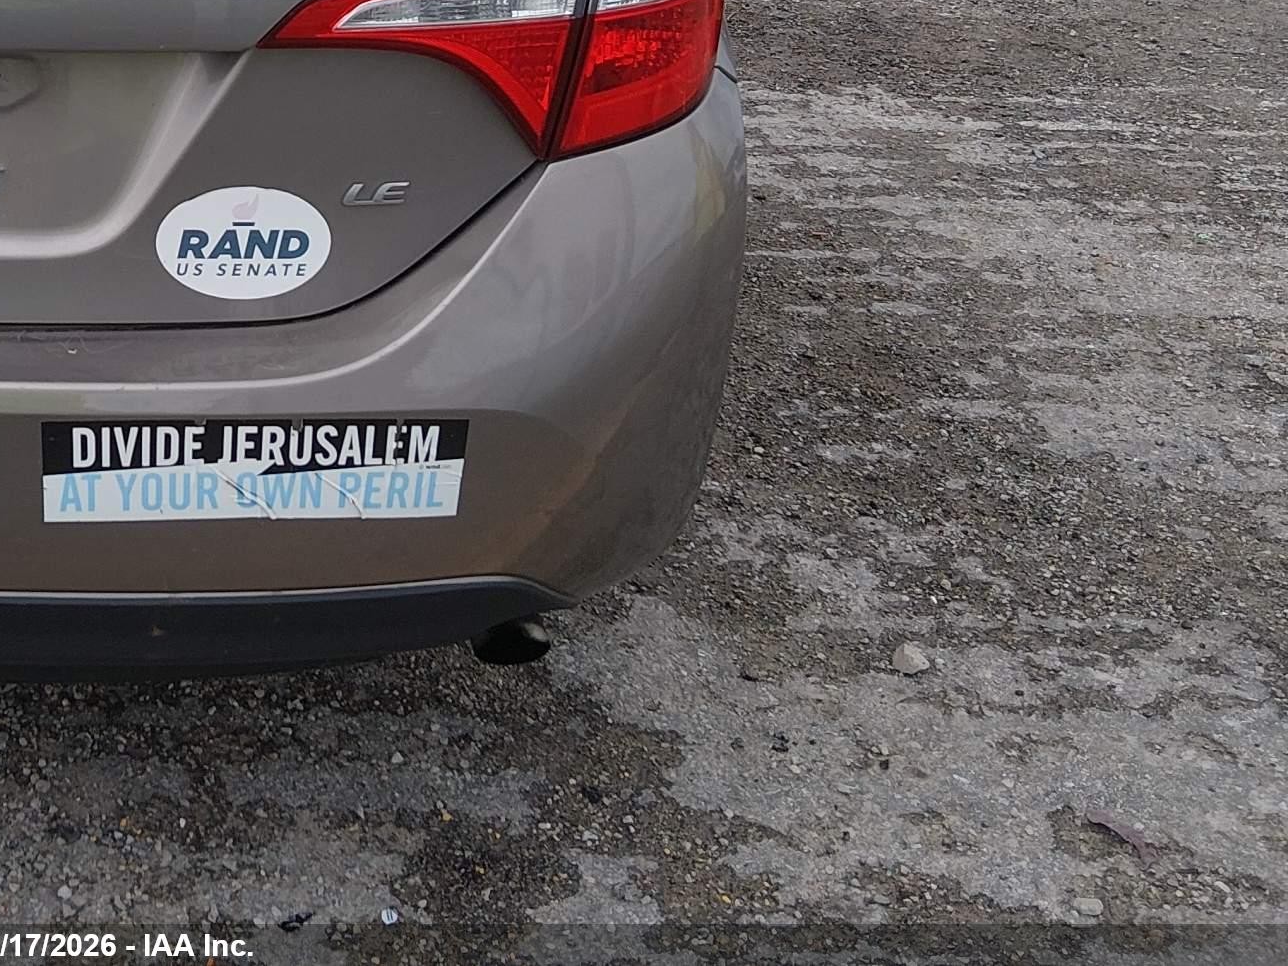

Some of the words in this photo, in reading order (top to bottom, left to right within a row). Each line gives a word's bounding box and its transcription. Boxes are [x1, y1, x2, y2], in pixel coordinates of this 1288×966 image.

[341, 181, 410, 206] LE
[176, 229, 310, 259] RAND
[176, 263, 203, 276] US
[216, 263, 308, 277] SENATE
[72, 426, 205, 468] DIVIDE
[218, 425, 441, 465] JERUSALEM
[60, 473, 102, 512] AT
[113, 471, 218, 511] YOUR
[236, 470, 322, 509] OWN
[339, 469, 443, 508] PERIL
